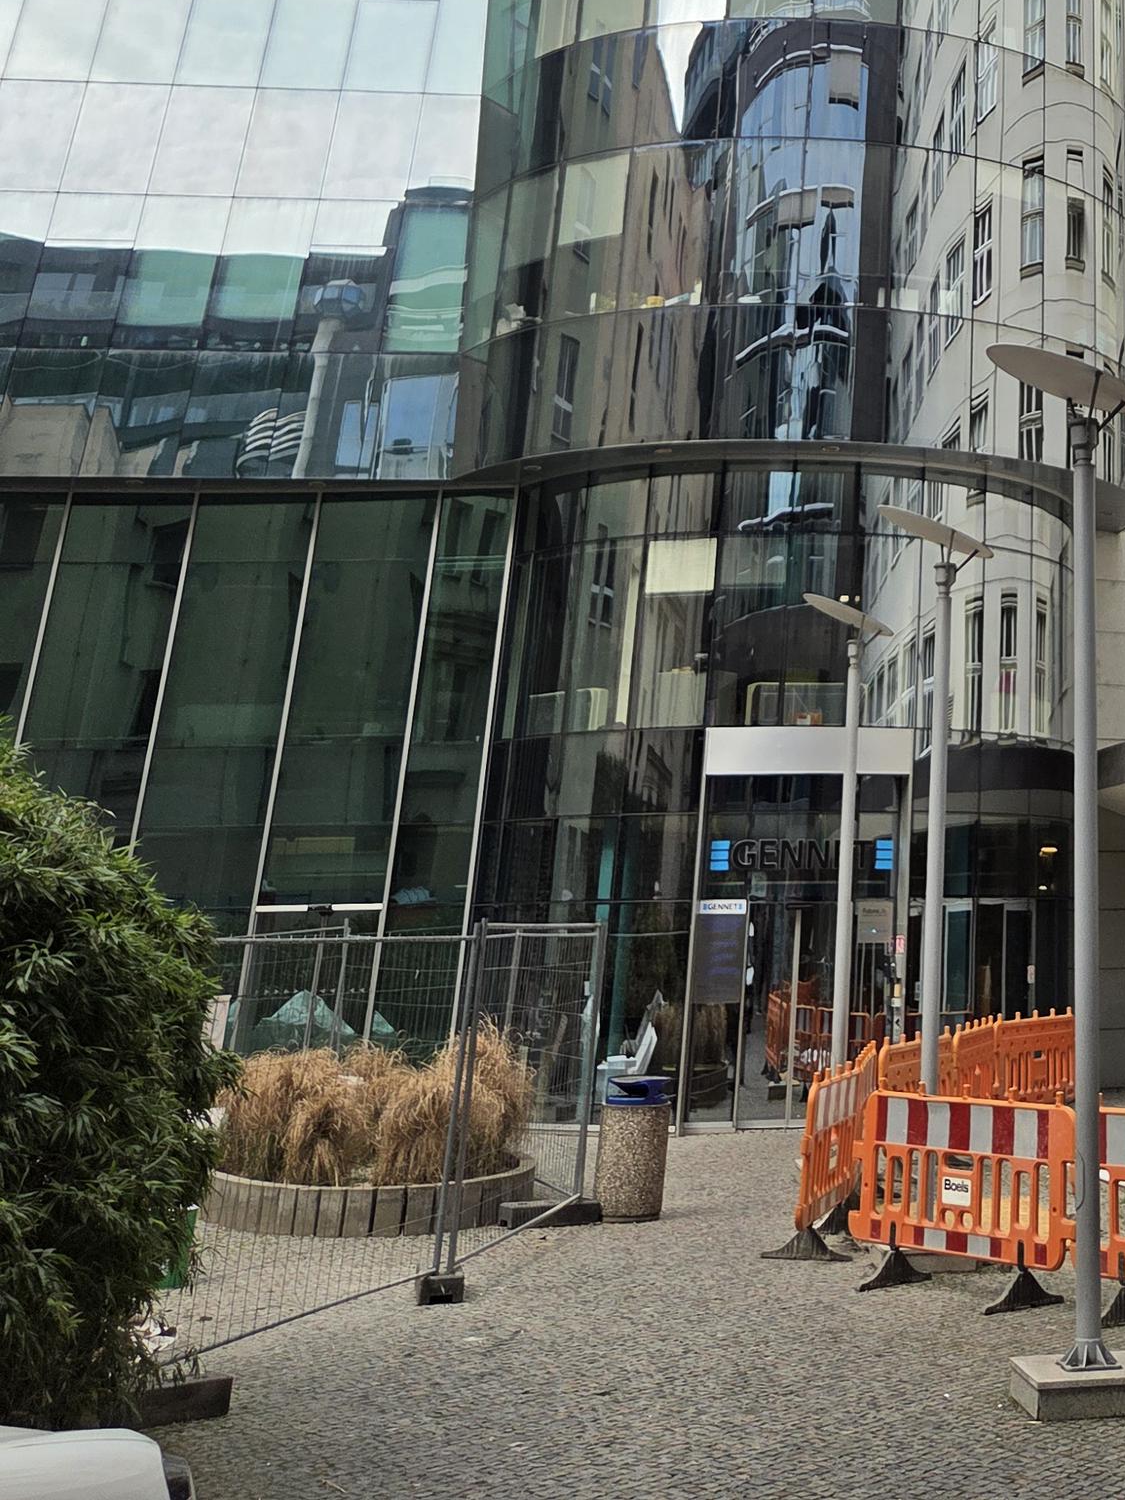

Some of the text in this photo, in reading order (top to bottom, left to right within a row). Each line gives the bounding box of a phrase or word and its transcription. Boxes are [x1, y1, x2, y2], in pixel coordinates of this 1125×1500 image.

[731, 838, 873, 870] GENNT
[707, 902, 738, 911] GENNET
[943, 1178, 969, 1193] Boels
